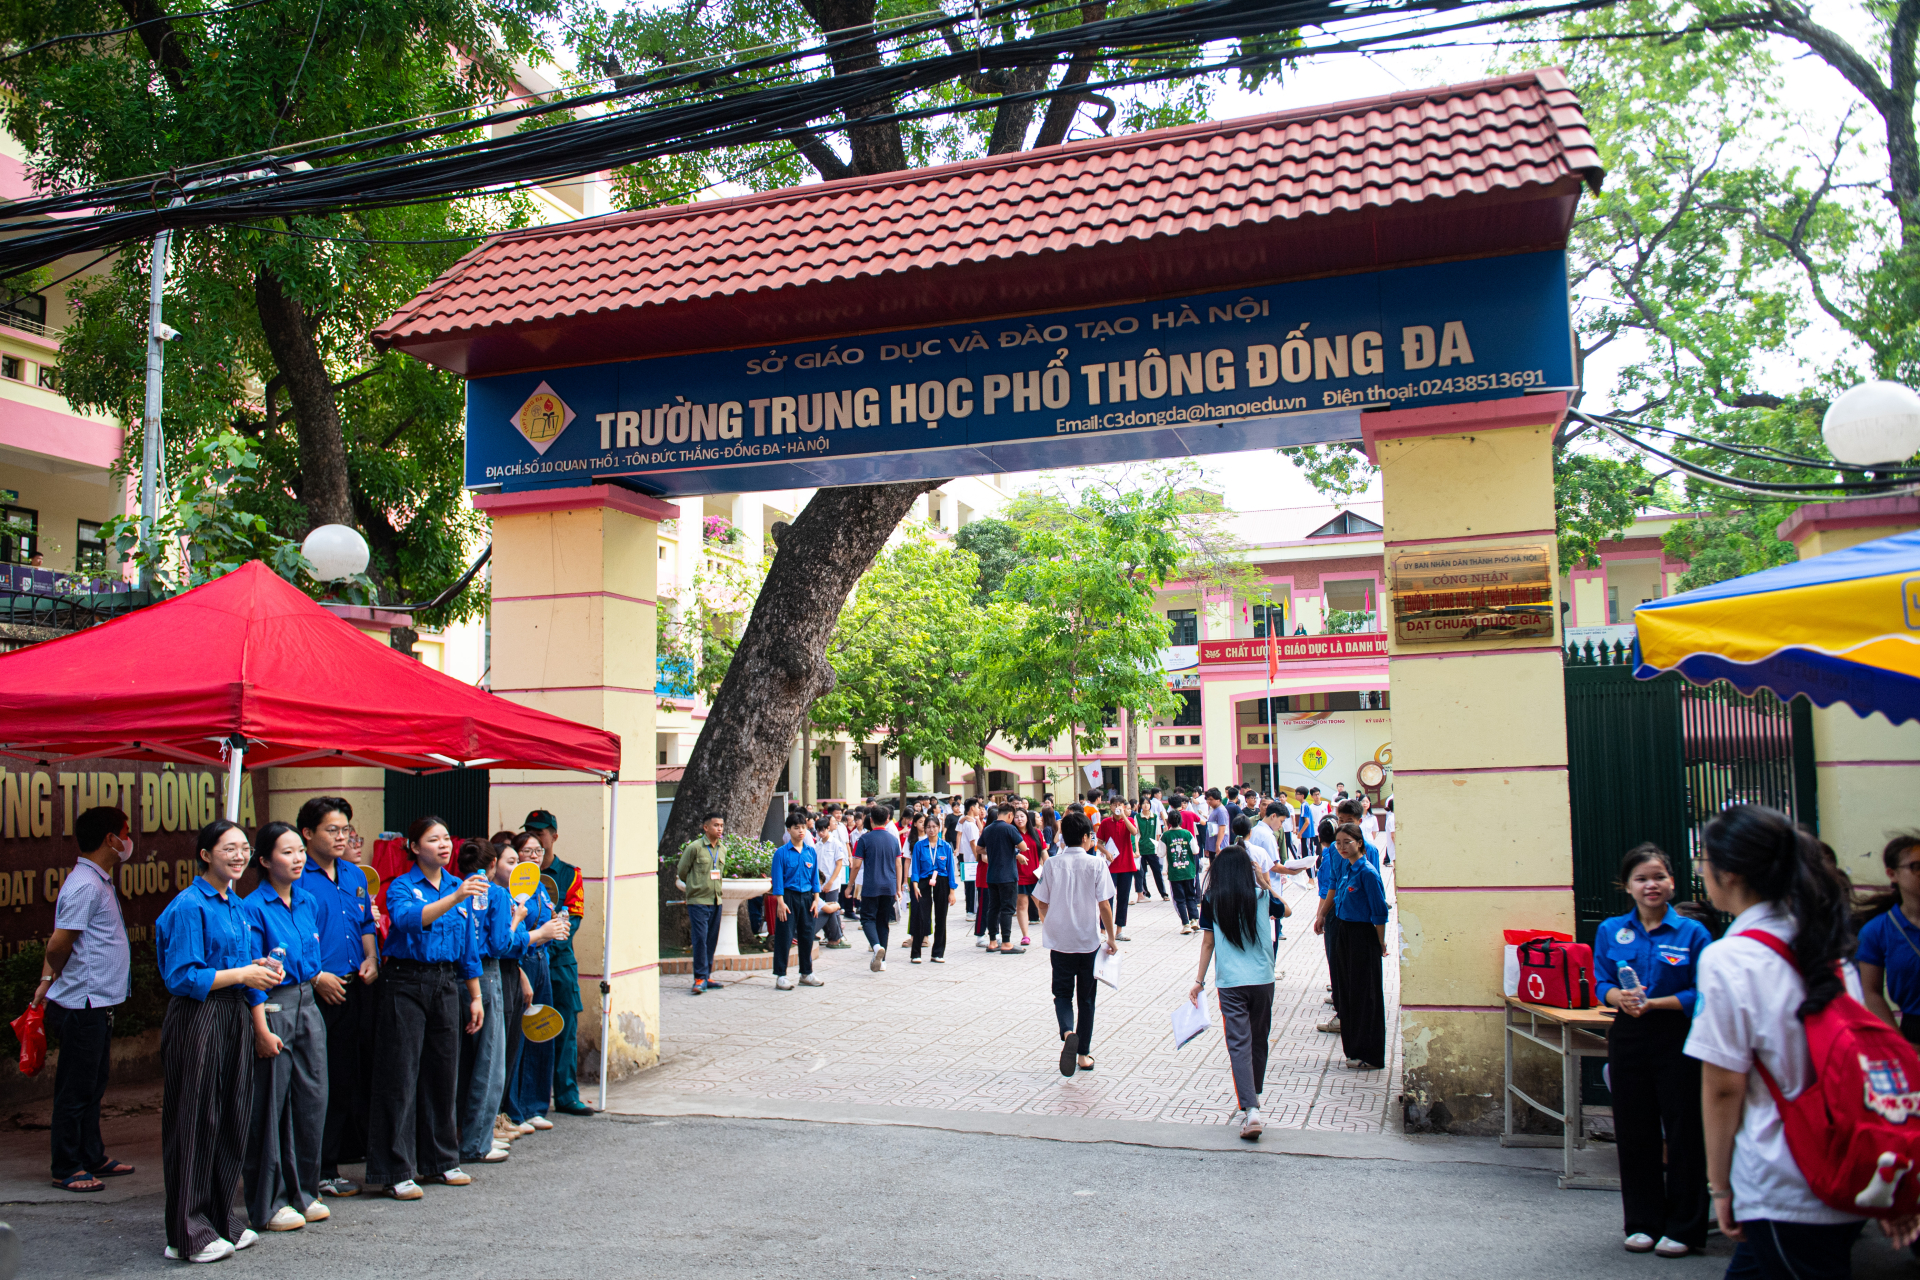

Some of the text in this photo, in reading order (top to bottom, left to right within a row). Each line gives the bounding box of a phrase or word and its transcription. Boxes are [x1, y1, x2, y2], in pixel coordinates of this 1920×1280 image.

[747, 296, 1269, 374] SỞ GIÁO DỤC VÀ ĐÀO TẠO HÀ NỘI
[596, 320, 1474, 450] TRƯỜNG TRUNG HỌC PHỔ THÔNG ĐỐNG ĐA
[1323, 389, 1364, 407] Điện
[486, 466, 503, 480] ĐỊA
[541, 461, 553, 473] 10
[554, 458, 588, 473] QUAN
[590, 451, 613, 468] THỔ
[651, 449, 677, 464] ĐỨC
[762, 443, 780, 456] ĐA
[807, 435, 830, 453] NỘI
[1414, 561, 1429, 569] BAN
[1431, 558, 1451, 568] NHÂN
[1452, 557, 1468, 567] DÂN
[1469, 555, 1493, 566] THÀNH
[1494, 554, 1509, 563] PHỐ
[1511, 553, 1521, 562] HÀ
[1523, 553, 1537, 562] NỘI
[1433, 571, 1508, 585] CÔNG NHẬN
[1406, 612, 1541, 634] ĐẠT CHUẨN QUỐC GIA
[1225, 643, 1249, 658] CHẤT
[1284, 643, 1307, 656] GIÁO
[1308, 643, 1328, 656] DỤC
[1330, 640, 1343, 653] LÀ
[1345, 641, 1373, 653] DANH
[0, 766, 52, 838] NG
[120, 850, 170, 900] QUỐC
